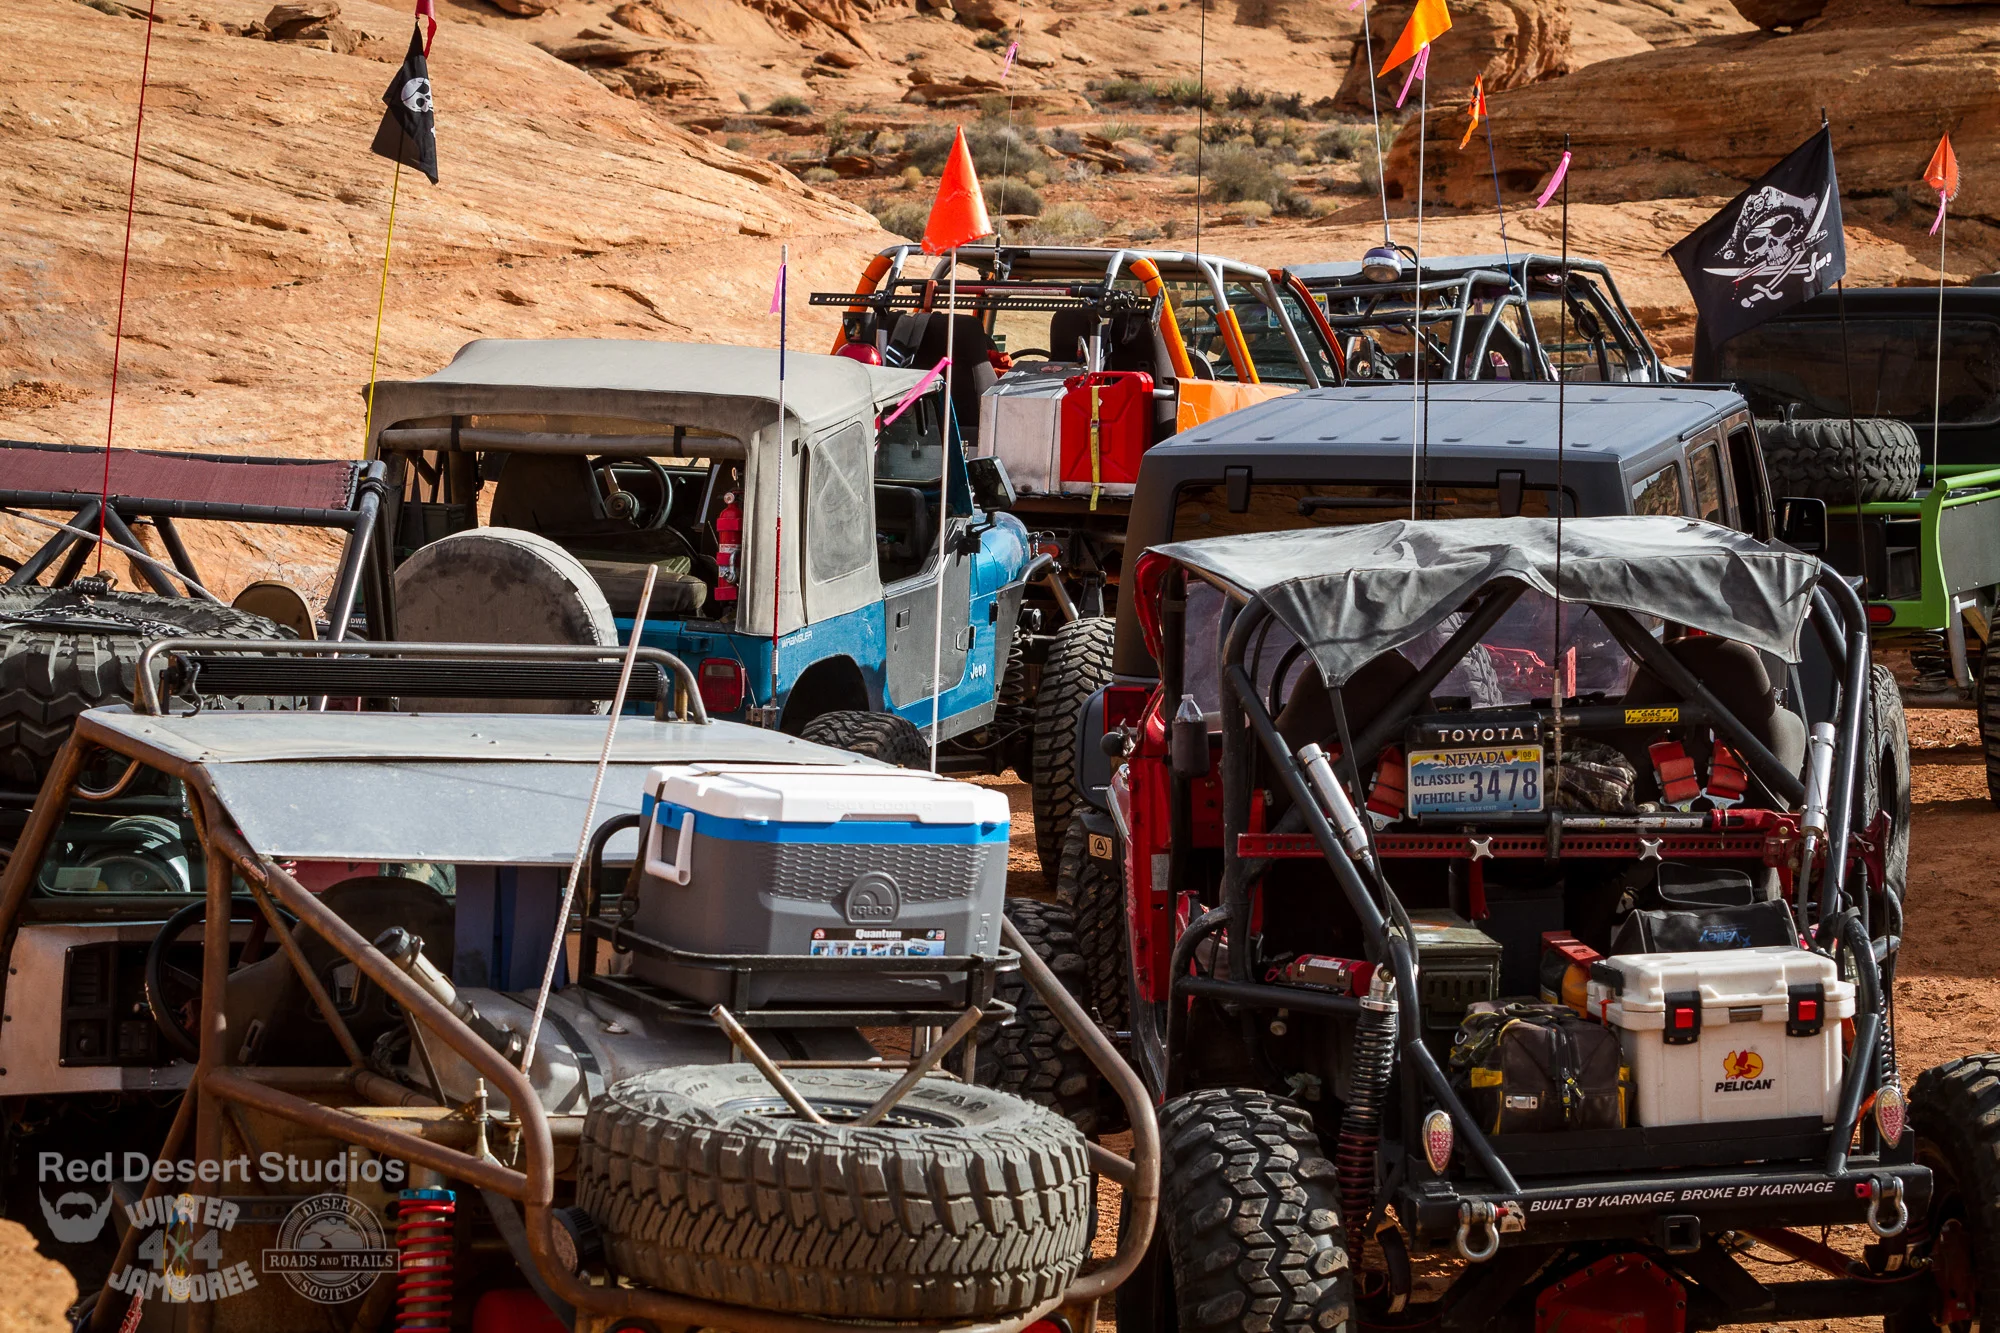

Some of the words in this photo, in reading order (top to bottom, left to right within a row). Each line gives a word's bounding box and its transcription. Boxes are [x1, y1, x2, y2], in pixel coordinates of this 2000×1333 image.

[781, 630, 813, 648] WRANGLER
[970, 662, 987, 680] Jeep
[1438, 727, 1524, 743] TOYOTA
[1445, 751, 1507, 766] NEVADA
[1522, 751, 1532, 759] 08
[1414, 773, 1466, 787] CLASSIC
[1469, 768, 1538, 803] 3478
[1414, 791, 1467, 805] VEHICLE
[852, 905, 893, 919] IGLOO
[855, 928, 902, 940] Quantum
[1699, 930, 1741, 943] Valley
[1715, 1079, 1773, 1092] PELICAN
[1530, 1198, 1573, 1212] BUILT
[1575, 1197, 1598, 1209] BY
[1598, 1191, 1676, 1207] KARNAGE,
[1680, 1187, 1734, 1201] BROKE
[1737, 1185, 1759, 1198] BY
[1759, 1181, 1836, 1197] KARNAGE
